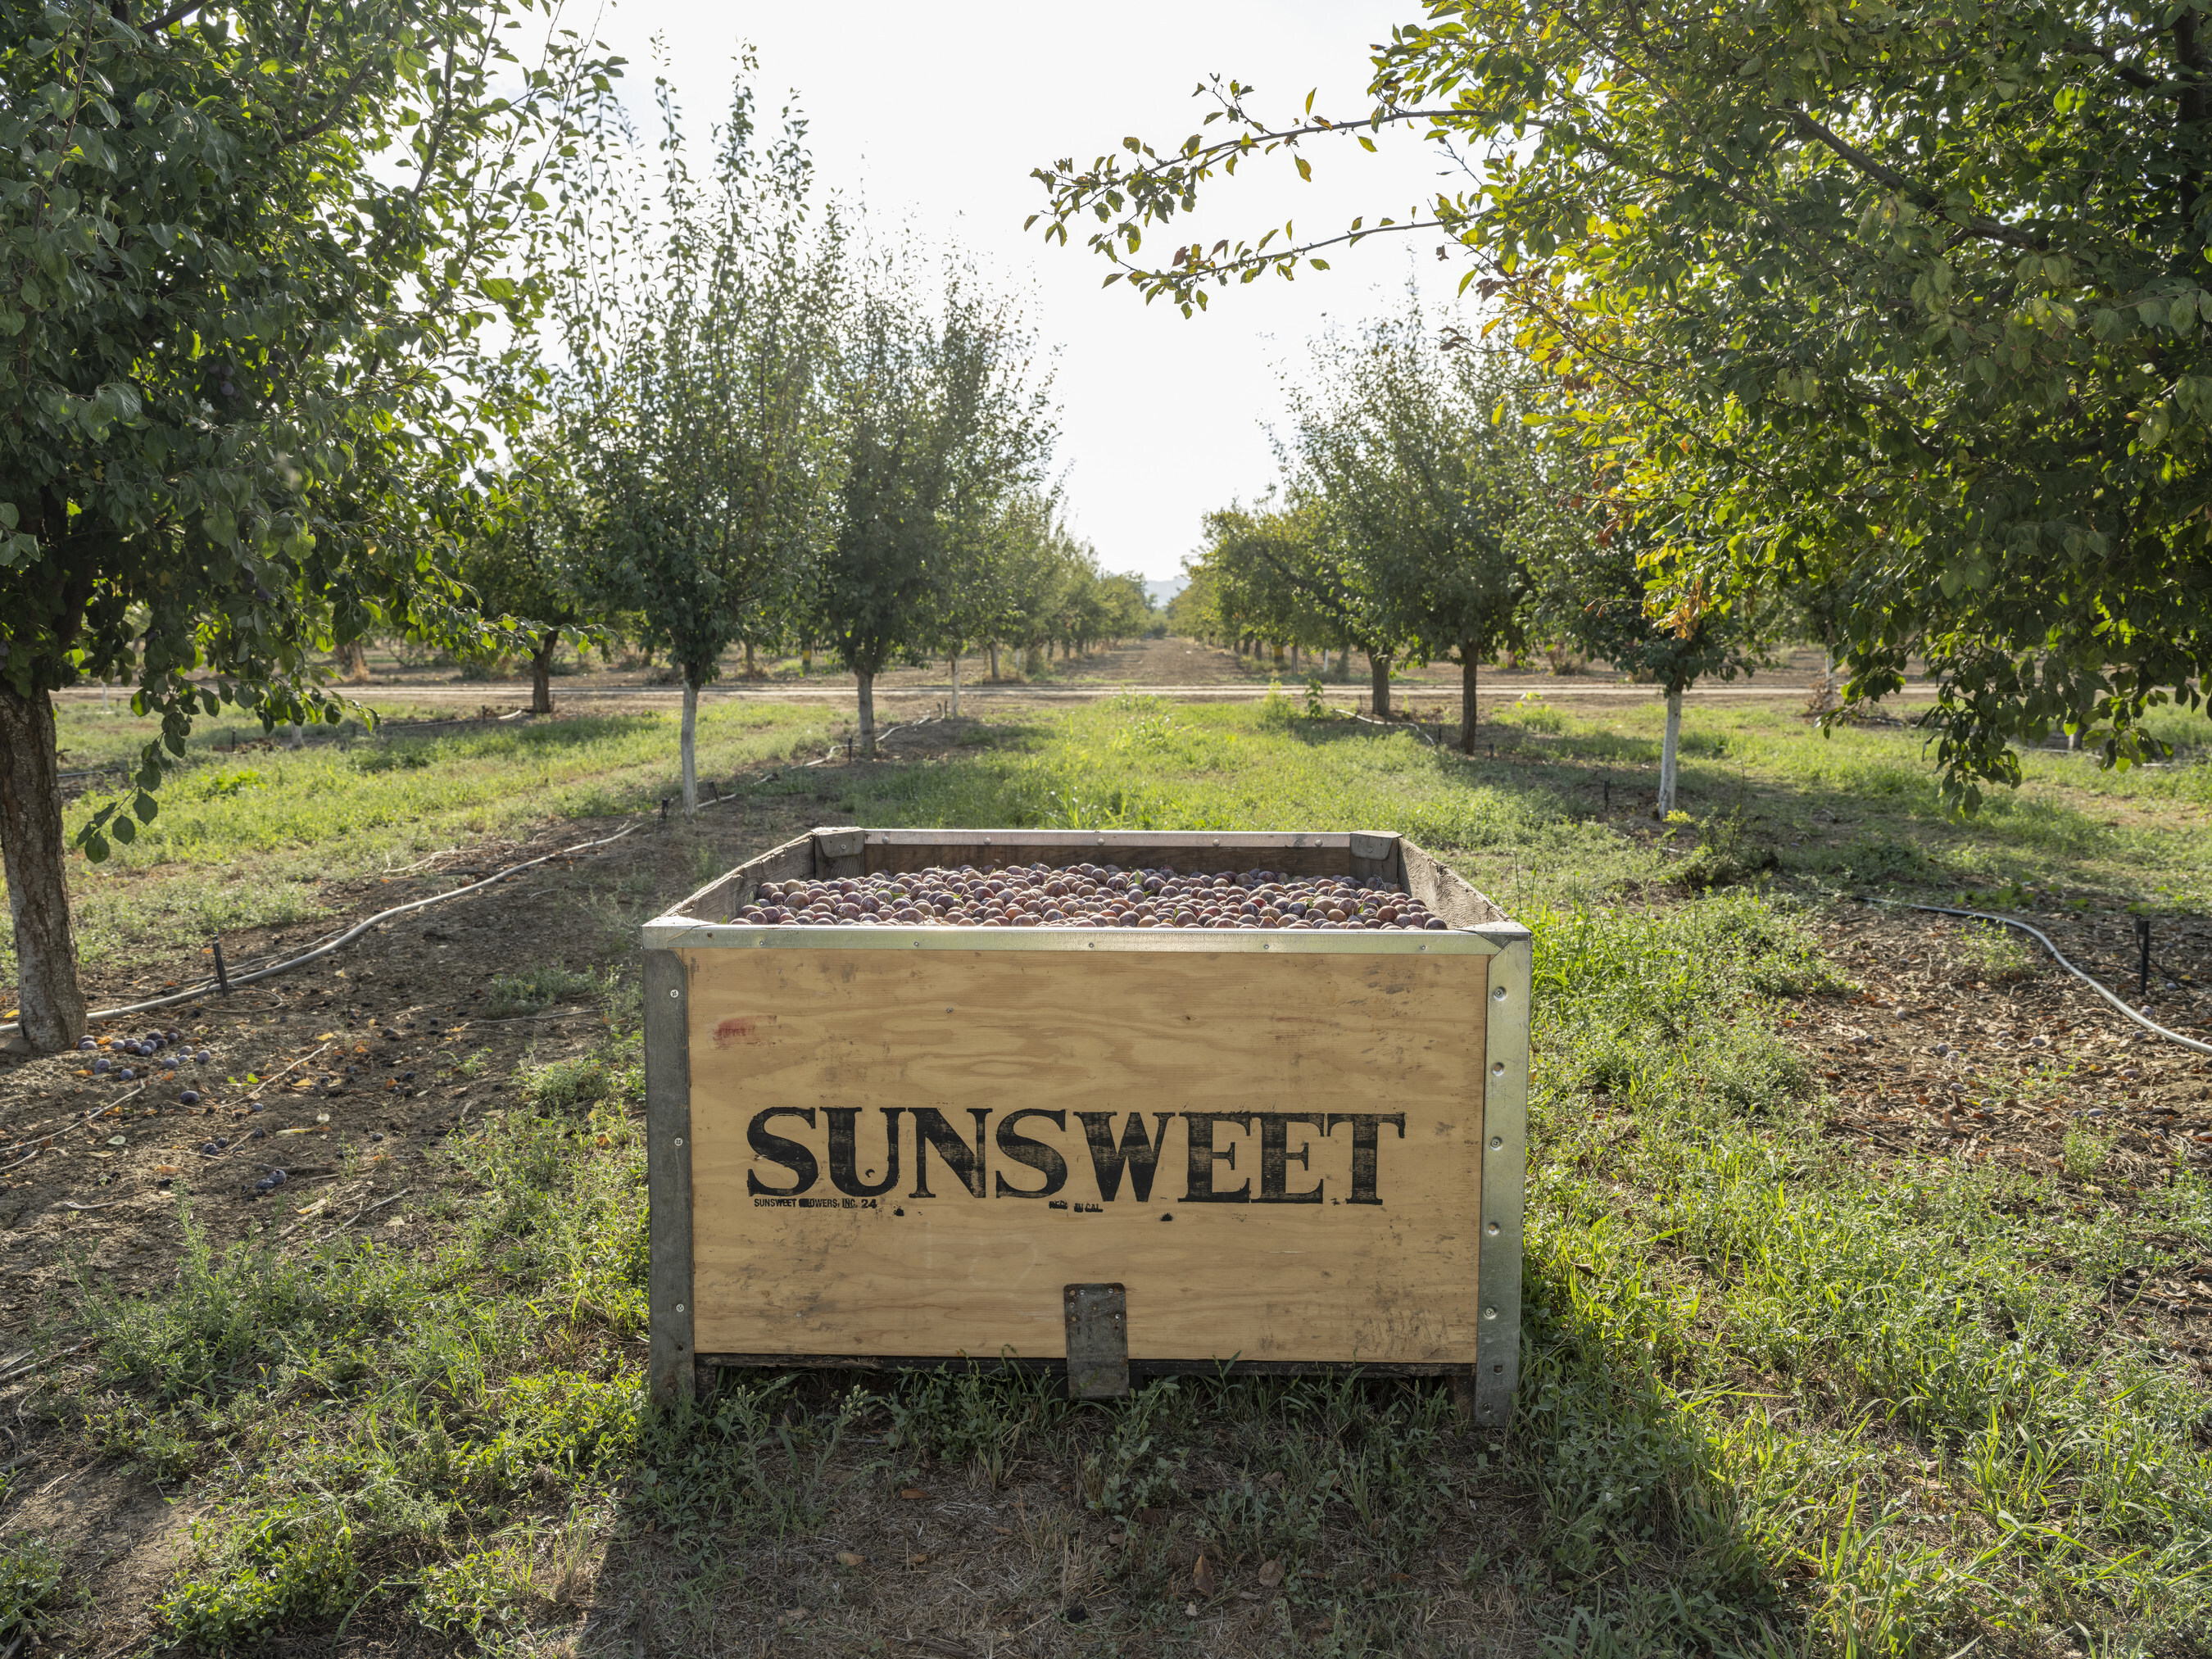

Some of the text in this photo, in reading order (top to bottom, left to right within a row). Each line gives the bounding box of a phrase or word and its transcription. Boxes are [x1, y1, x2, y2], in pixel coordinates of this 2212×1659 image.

[746, 1106, 1407, 1205] SUNSWEET
[754, 1199, 796, 1208] SUNSWEET
[799, 1199, 840, 1208] OWERS,
[861, 1199, 877, 1209] 24
